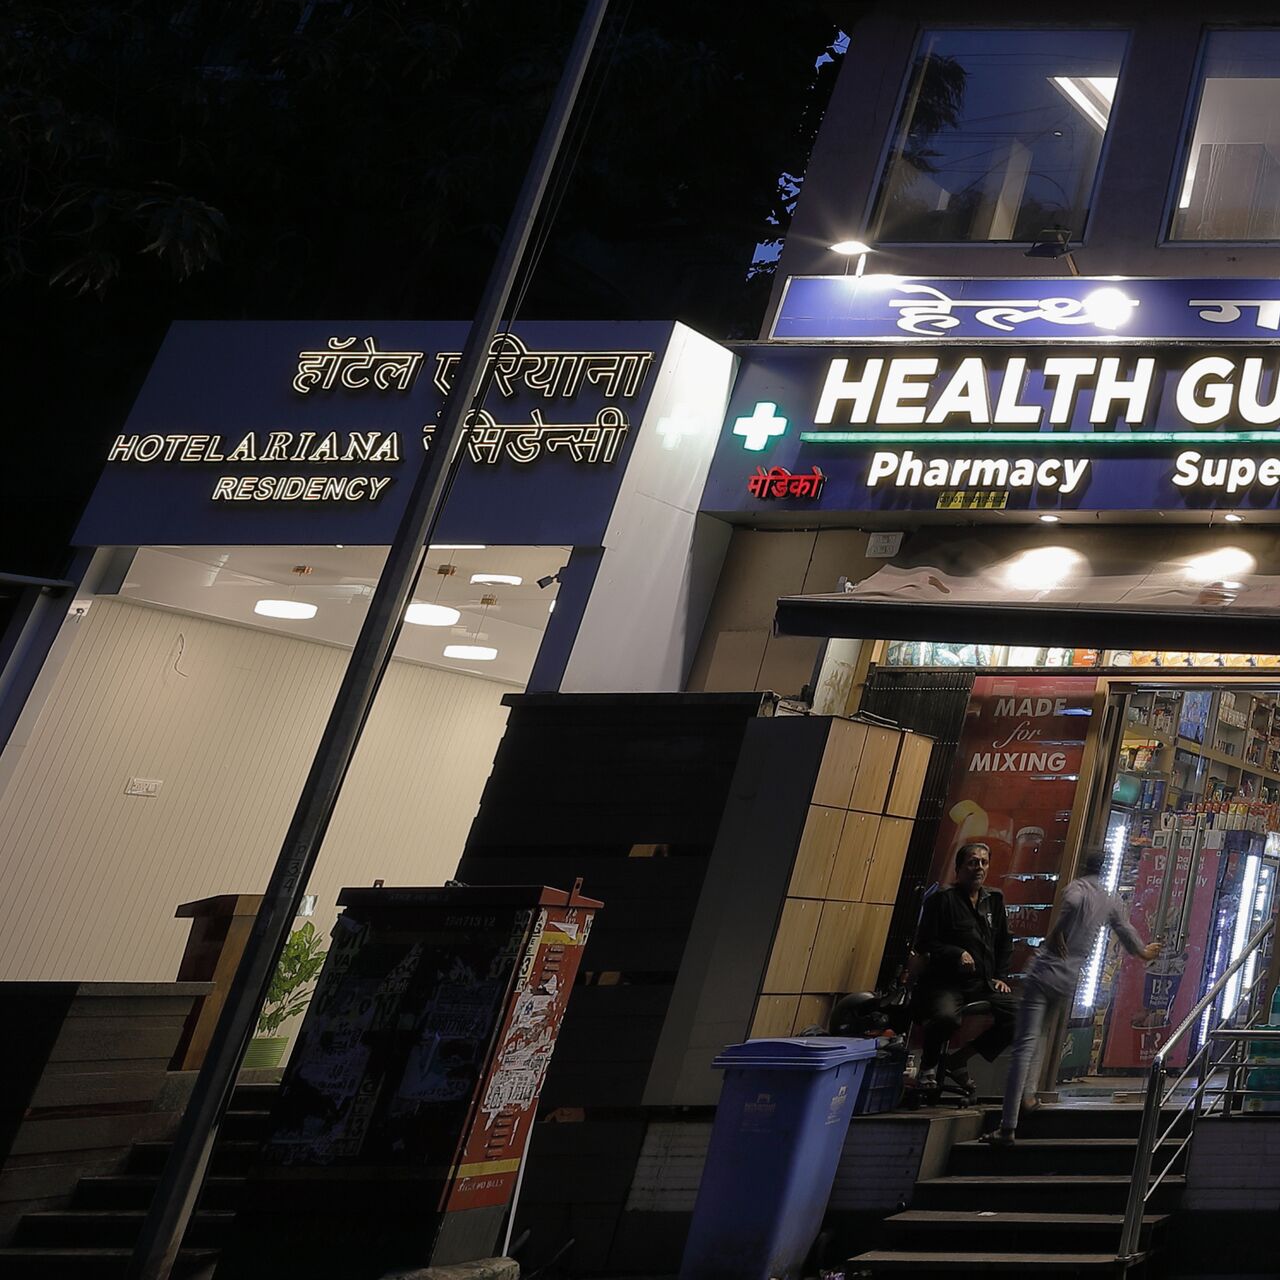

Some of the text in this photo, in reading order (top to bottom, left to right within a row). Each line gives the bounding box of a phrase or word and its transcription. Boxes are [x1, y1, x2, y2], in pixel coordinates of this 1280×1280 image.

[292, 336, 423, 396] हॉटेल
[813, 357, 1156, 425] HEALTH
[107, 430, 401, 462] HOTEL ARIANA
[211, 475, 391, 502] RESIDENCY
[747, 465, 823, 498] मेडिको
[866, 451, 1090, 494] Pharmacy
[994, 697, 1067, 717] MADE
[992, 720, 1041, 749] for
[968, 751, 1067, 772] MIXING
